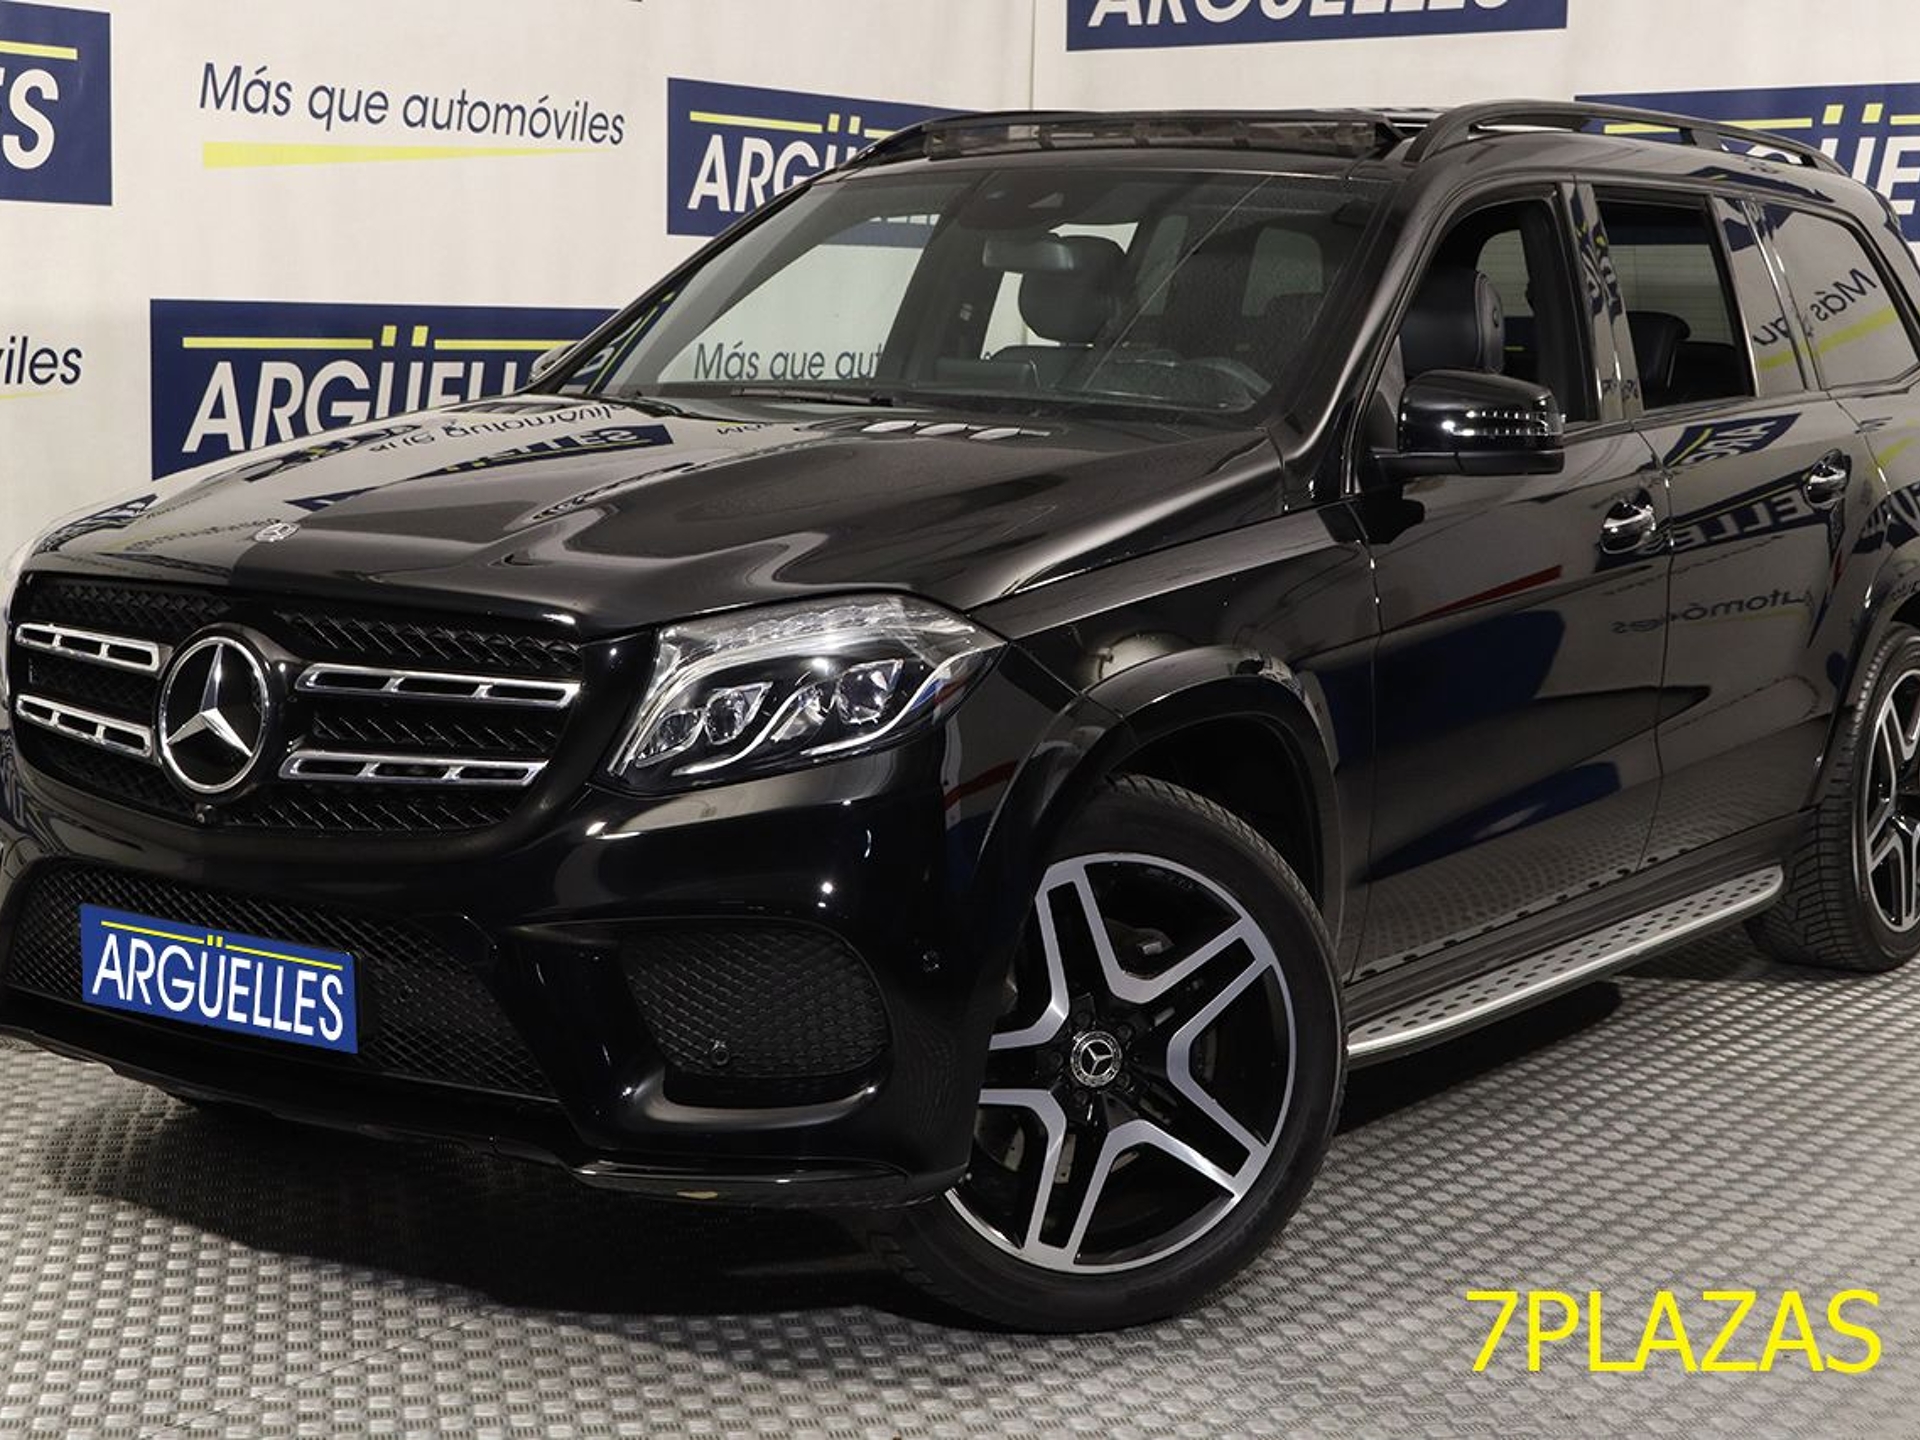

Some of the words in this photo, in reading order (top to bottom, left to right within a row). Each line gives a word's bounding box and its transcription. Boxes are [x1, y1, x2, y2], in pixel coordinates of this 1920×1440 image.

[199, 62, 293, 117] Más
[307, 84, 389, 131] que
[402, 88, 625, 146] automóviles
[694, 341, 760, 379] Más
[92, 933, 344, 1041] ARGÜELLES
